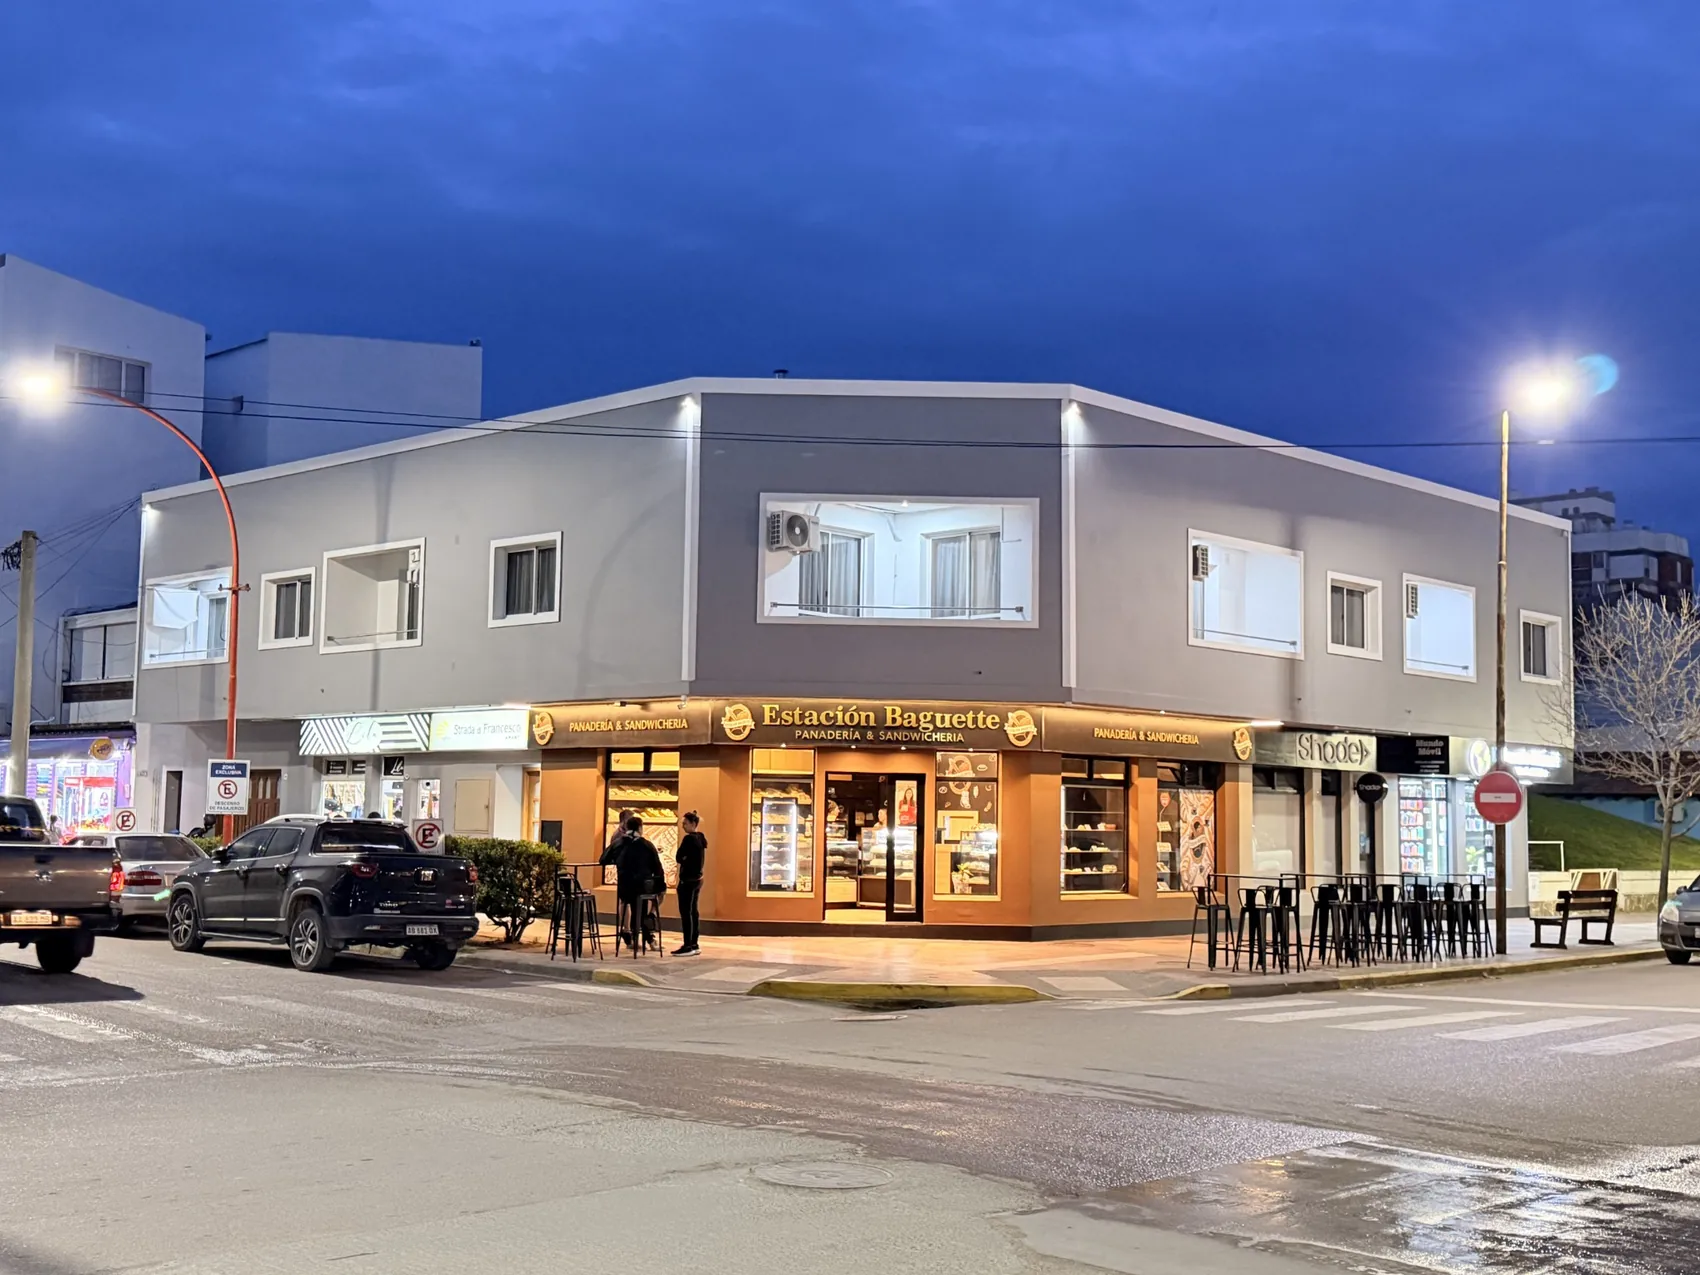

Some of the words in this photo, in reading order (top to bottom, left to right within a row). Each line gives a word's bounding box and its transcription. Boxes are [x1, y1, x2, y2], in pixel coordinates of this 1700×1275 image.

[762, 703, 876, 727] Estación
[883, 705, 1000, 731] Baguette
[453, 724, 475, 735] Strada
[569, 719, 614, 732] PANADERÍA
[616, 721, 623, 731] &
[624, 718, 688, 731] SANDWICHERIA
[795, 728, 861, 740] PANADERÍA
[866, 732, 874, 741] &
[879, 731, 965, 743] SANDWICHERIA
[1094, 727, 1137, 740] PANADERÍA
[1138, 731, 1145, 741] &
[1146, 731, 1199, 745] SANDWICHERIA
